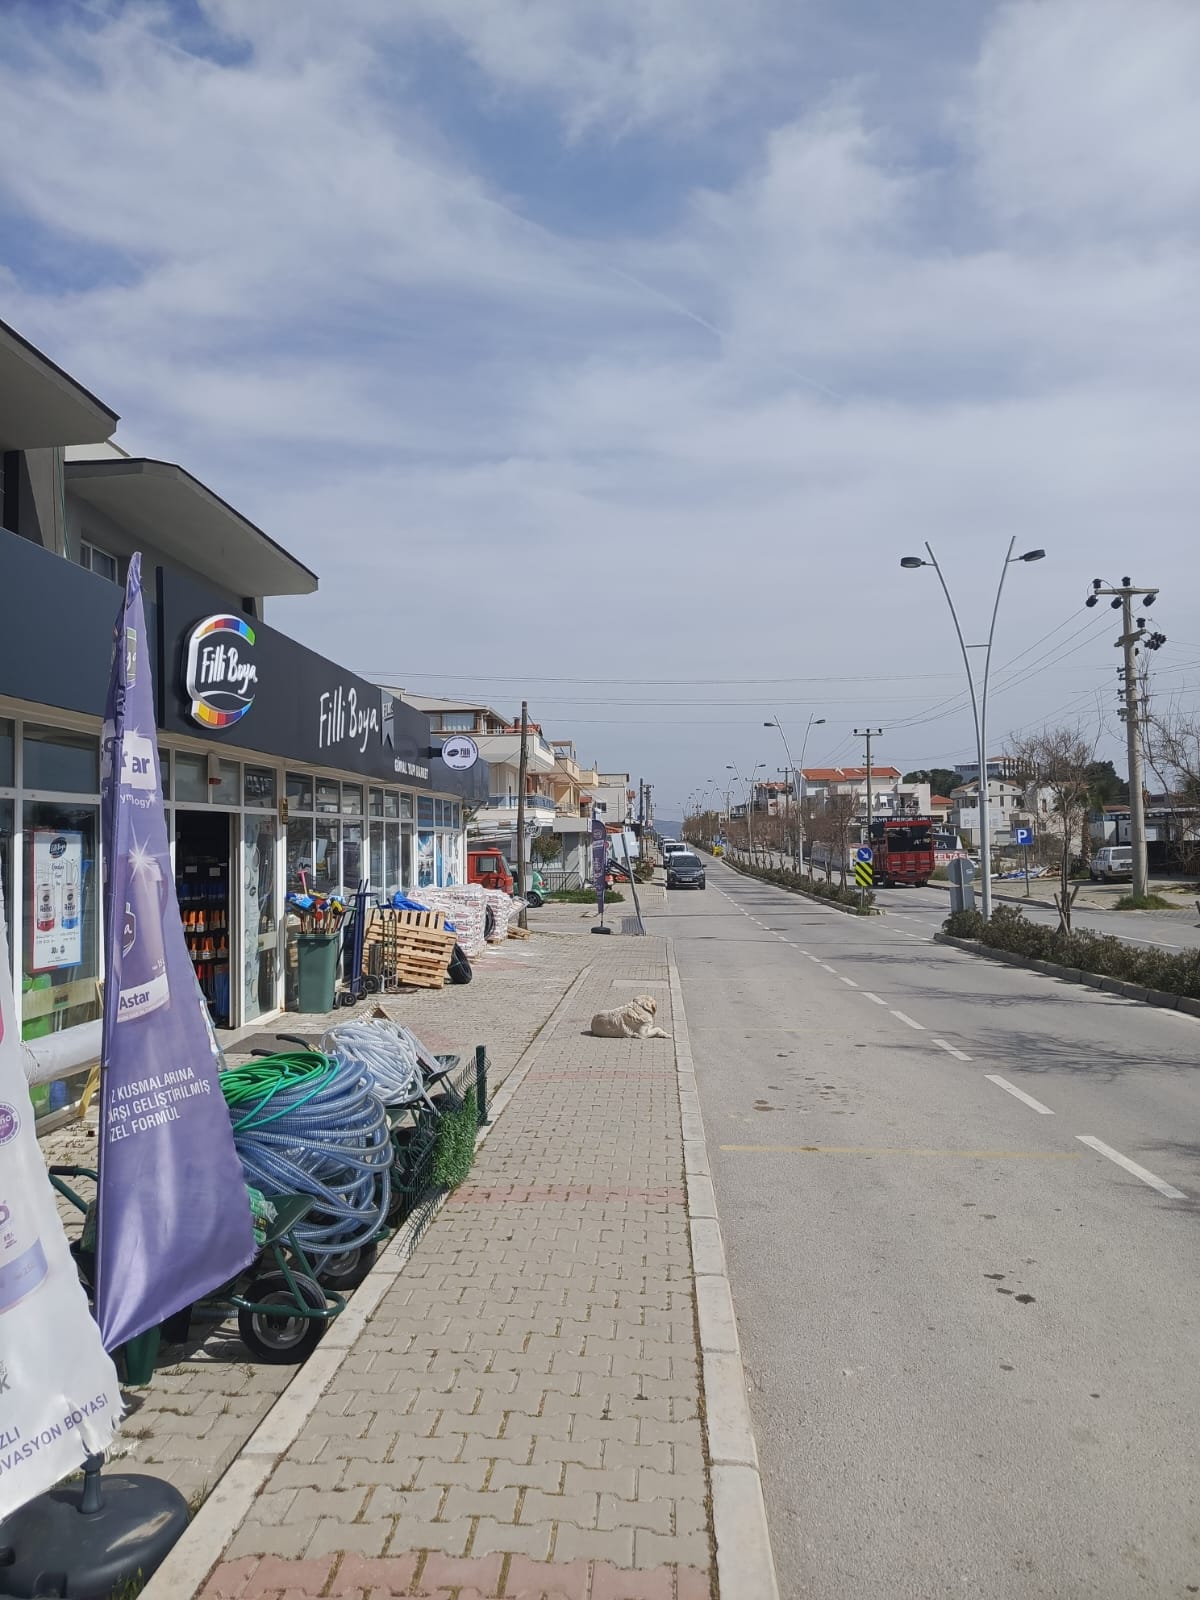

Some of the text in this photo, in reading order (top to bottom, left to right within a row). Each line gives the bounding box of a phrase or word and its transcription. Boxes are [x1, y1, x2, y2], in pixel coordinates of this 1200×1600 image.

[200, 644, 259, 694] Filli Boya
[319, 685, 379, 753] Filli Boya
[1017, 829, 1028, 843] P
[119, 990, 151, 1011] Astar
[116, 1067, 195, 1101] KUSMALARINA
[132, 1078, 211, 1114] GELİŞTİRİLMİŞ
[131, 1104, 181, 1134] FORMÜL
[0, 1393, 109, 1476] VASYON BOYASI
